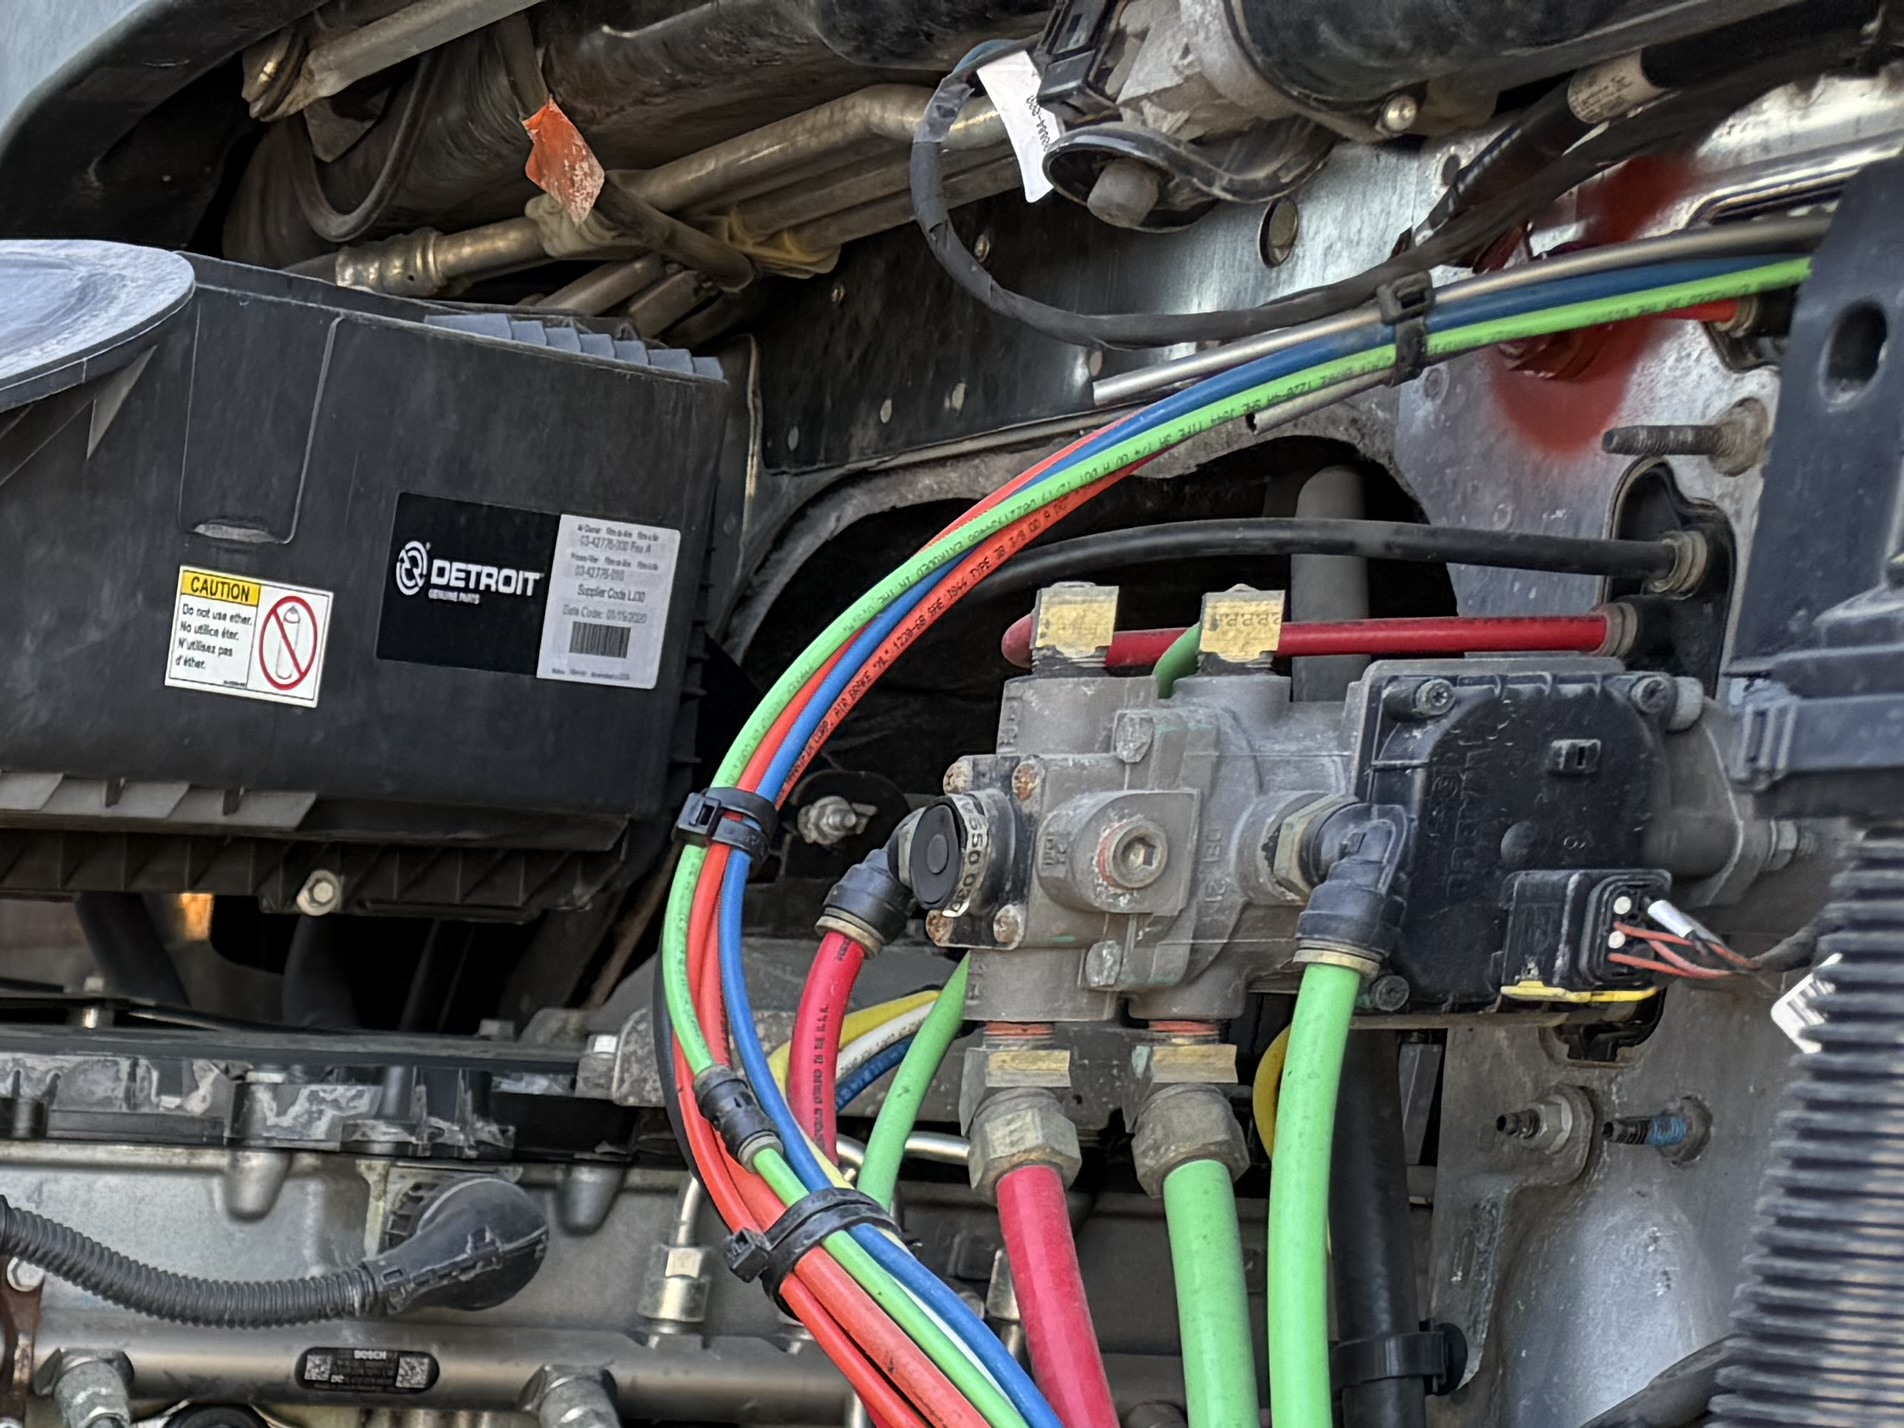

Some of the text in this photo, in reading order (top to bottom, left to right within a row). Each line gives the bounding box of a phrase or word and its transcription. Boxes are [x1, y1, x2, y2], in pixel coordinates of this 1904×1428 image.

[189, 575, 252, 604] CAUTION
[429, 558, 541, 598] DETROIT
[577, 583, 627, 601] Supplier Code
[181, 602, 255, 627] Do not use ether.
[353, 1350, 387, 1360] BOSCH
